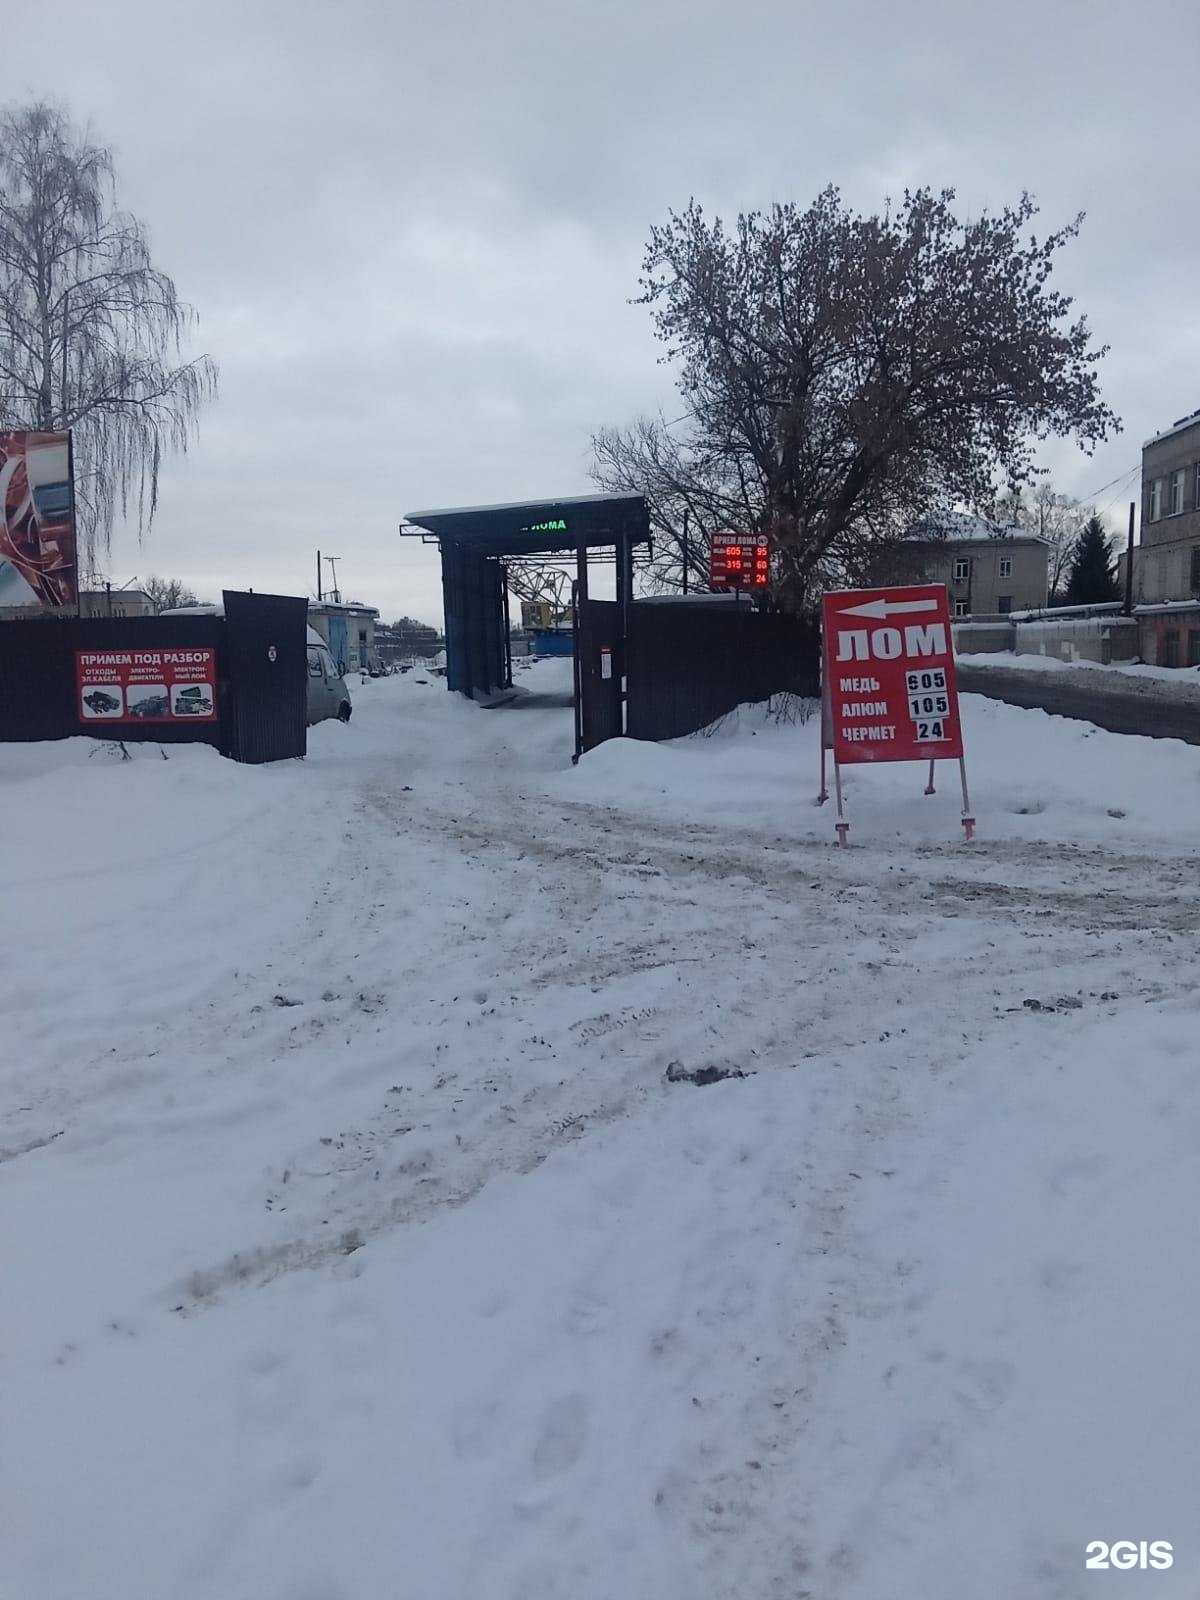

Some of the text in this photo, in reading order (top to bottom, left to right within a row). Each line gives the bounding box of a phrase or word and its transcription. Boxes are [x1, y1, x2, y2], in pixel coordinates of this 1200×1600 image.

[836, 623, 947, 661] ЛОМ
[80, 652, 210, 665] ПРИМЕМ ПОД РАЗБОР
[85, 668, 117, 676] ОТХОДЫ
[840, 672, 945, 693] МЕДЬ 605
[842, 696, 947, 718] АЛЮМ 105
[842, 722, 942, 742] ЧЕРМЕТ 24
